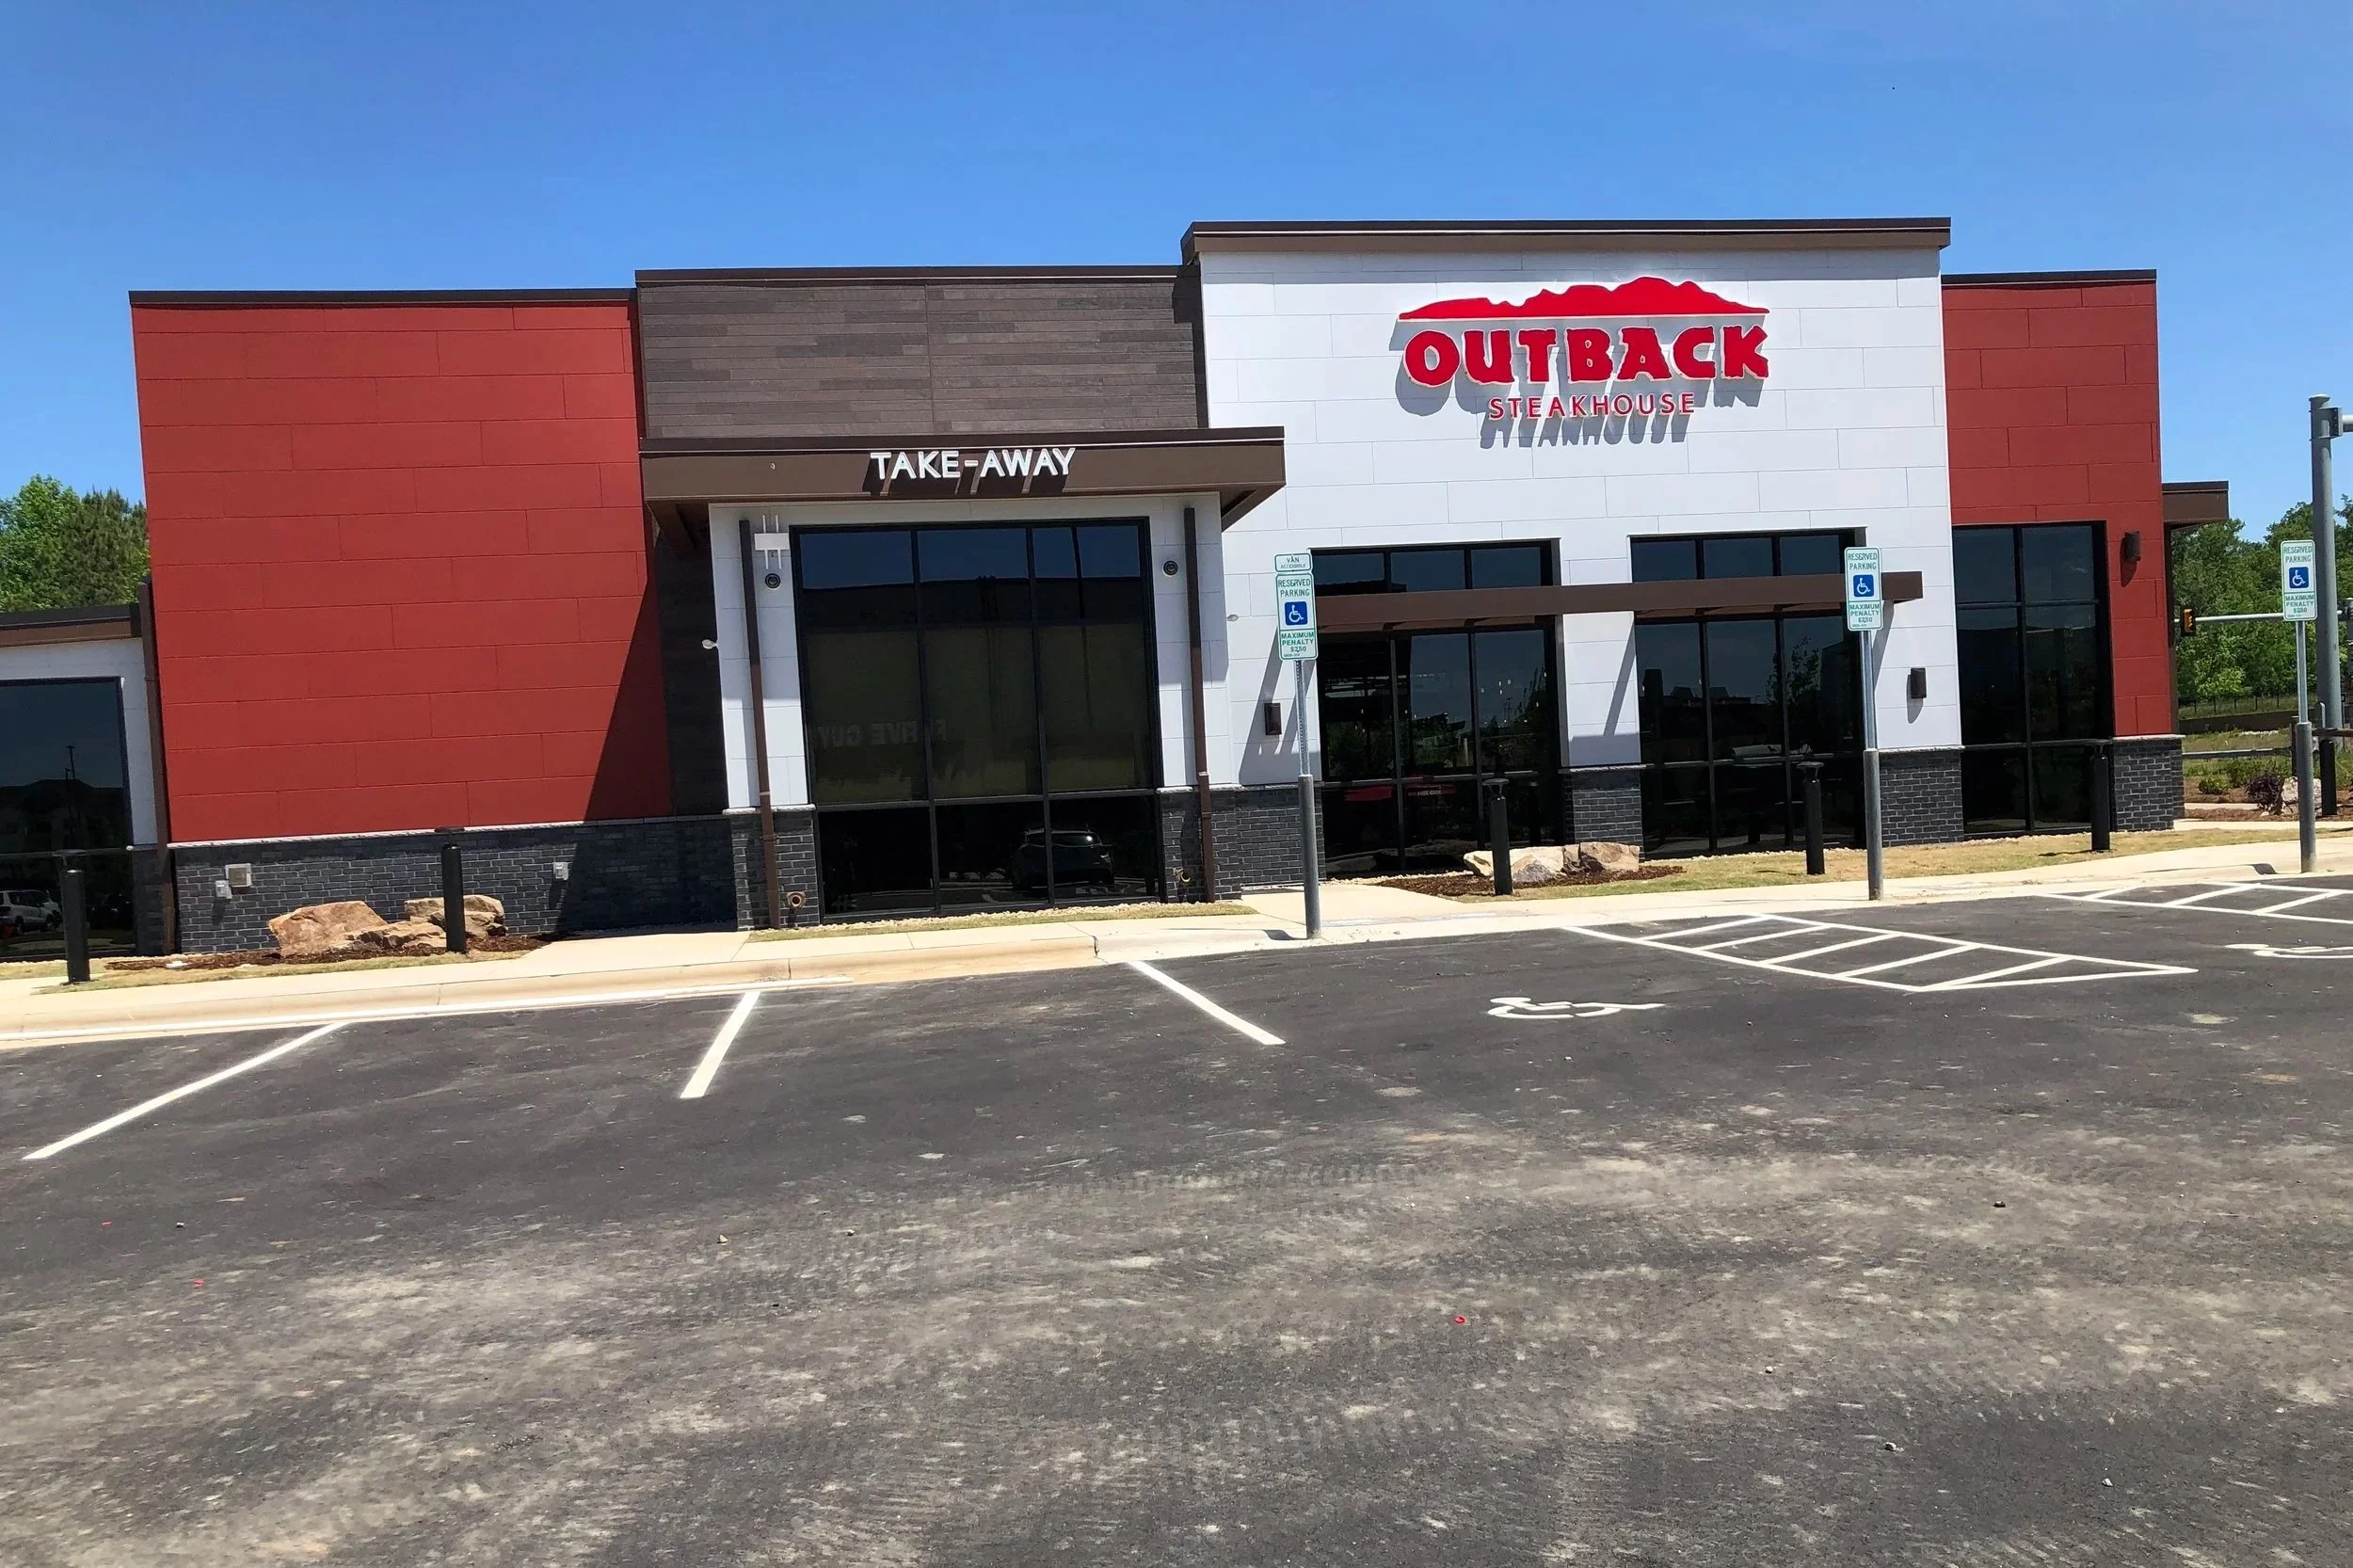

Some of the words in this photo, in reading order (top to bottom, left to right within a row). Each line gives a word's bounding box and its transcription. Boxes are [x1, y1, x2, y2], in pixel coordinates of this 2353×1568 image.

[1403, 325, 1769, 388] OUTBACK
[1488, 392, 1695, 421] STEAKHOUSE
[870, 447, 1076, 480] TAKE-AWAY
[2283, 546, 2313, 554] RESERVED
[1848, 552, 1878, 561] RESERVED
[1849, 562, 1877, 570] PARKING
[1277, 578, 1311, 587] RESERVED
[1280, 588, 1310, 598] PARKING
